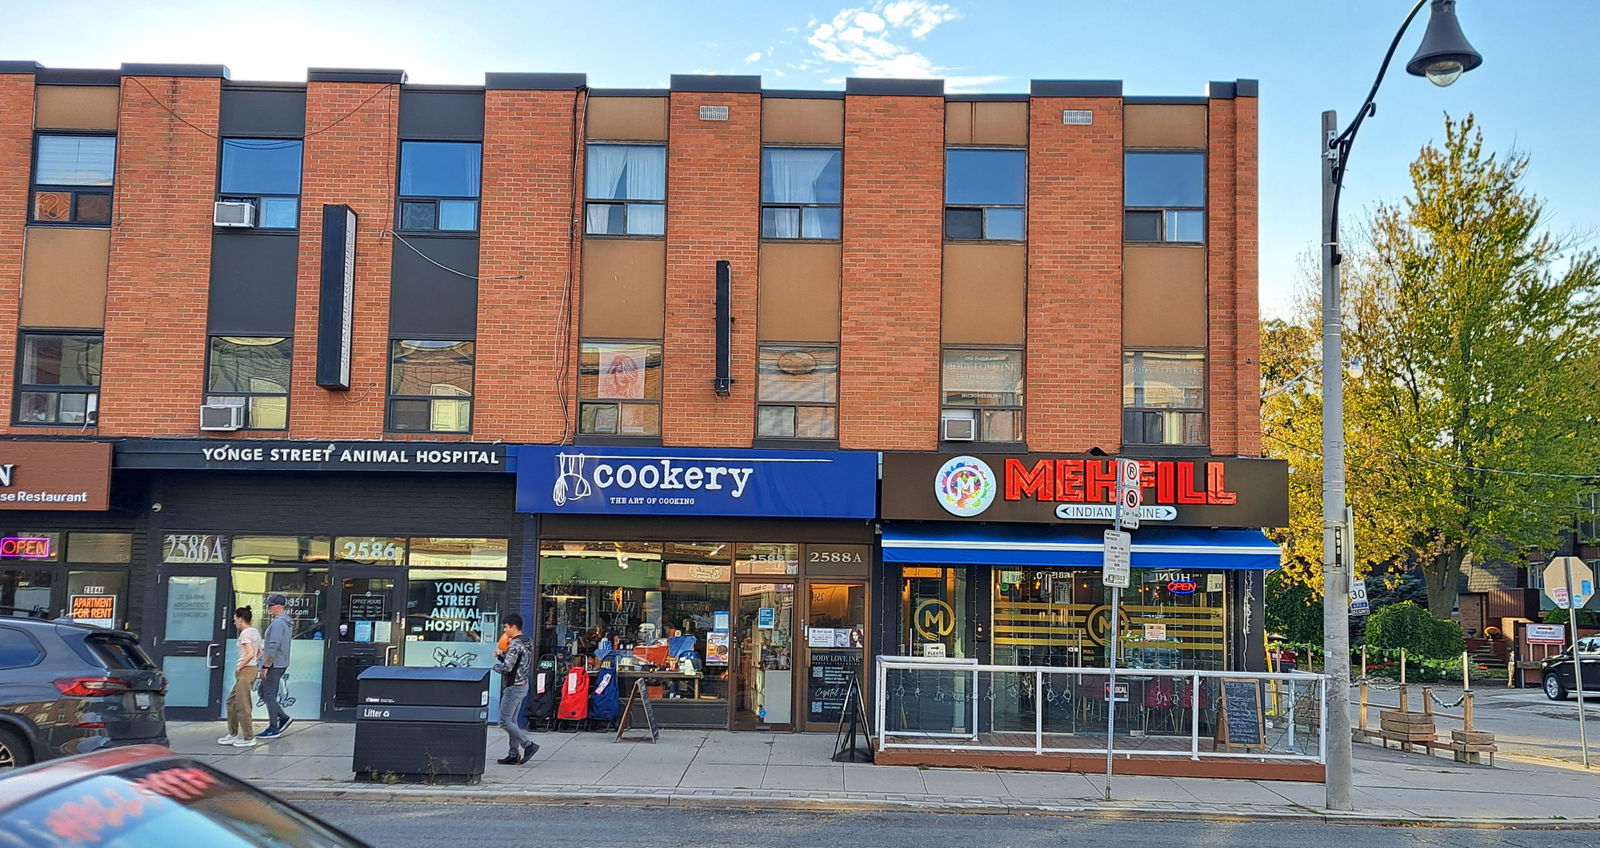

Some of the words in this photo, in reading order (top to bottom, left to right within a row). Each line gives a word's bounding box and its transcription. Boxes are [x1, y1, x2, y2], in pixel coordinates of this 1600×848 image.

[202, 448, 263, 461] YONGE
[269, 449, 333, 462] STREET
[339, 449, 409, 463] ANIMAL
[416, 450, 500, 464] HOSPITAL
[593, 459, 754, 498] cookery
[18, 491, 88, 503] Restaurant
[609, 497, 627, 505] THE
[628, 497, 645, 505] ART
[646, 497, 657, 505] OF
[658, 497, 696, 506] COOKING
[1071, 505, 1113, 519] INDIAN
[2, 540, 48, 556] OPEN
[163, 534, 225, 564] 2586A
[343, 541, 398, 560] 2586
[809, 551, 863, 563] 2588A
[434, 582, 481, 594] YONGE
[1167, 581, 1198, 592] OPEN
[436, 594, 478, 607] STREET
[1352, 589, 1366, 600] 30
[73, 597, 113, 608] APARTMENT
[73, 607, 90, 619] FOR
[90, 607, 113, 619] RENT
[430, 608, 482, 620] ANIMAL
[425, 620, 484, 633] HOSPITA
[812, 654, 830, 662] BODY
[830, 654, 848, 662] LOVE
[363, 708, 382, 718] Litter
